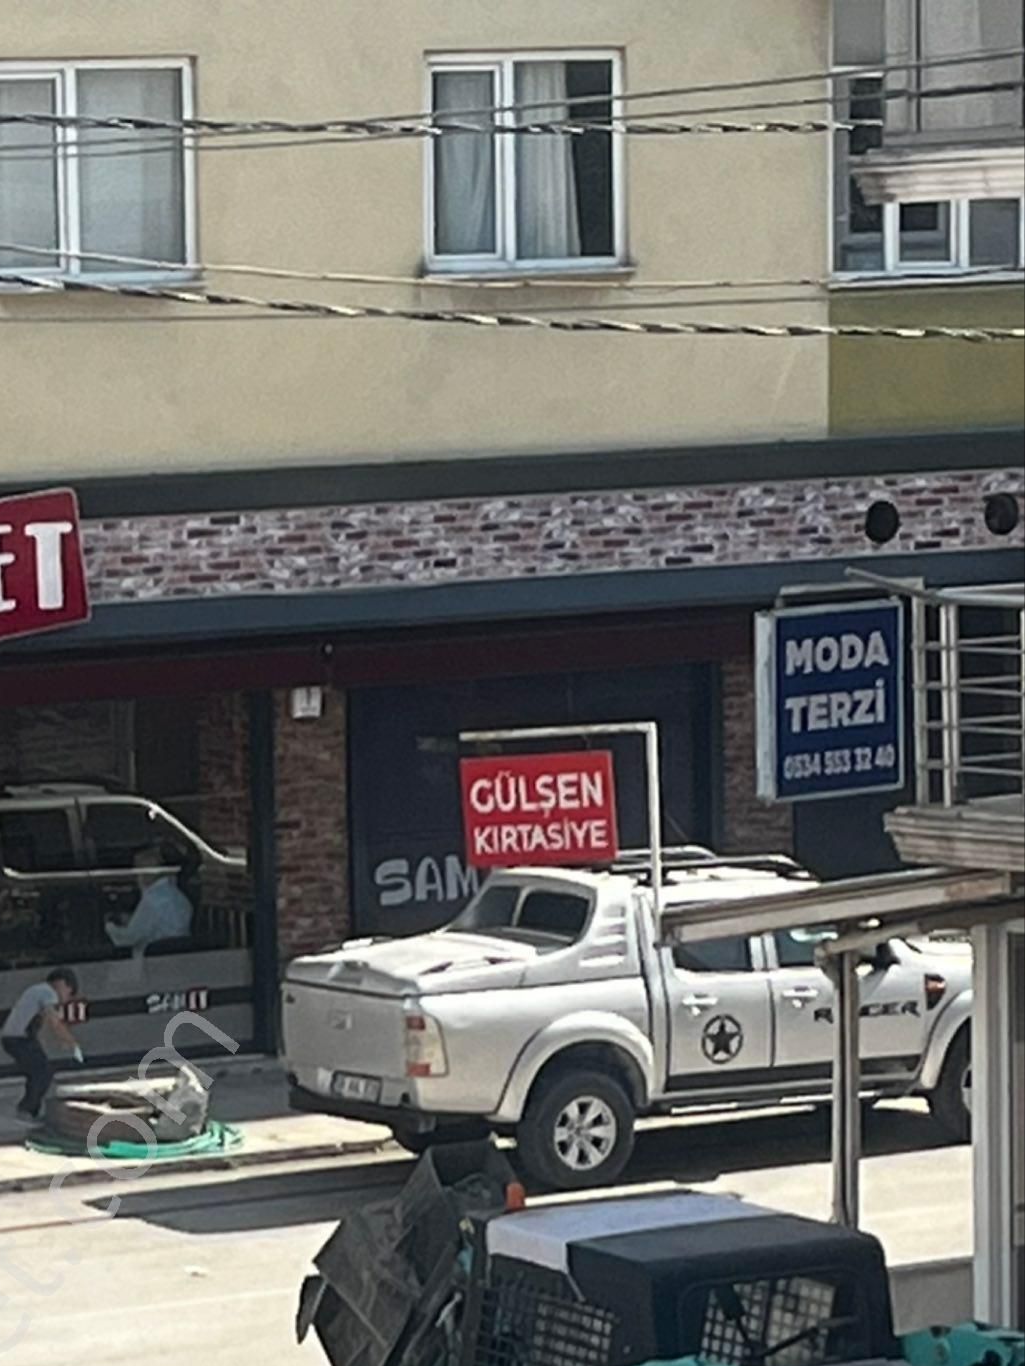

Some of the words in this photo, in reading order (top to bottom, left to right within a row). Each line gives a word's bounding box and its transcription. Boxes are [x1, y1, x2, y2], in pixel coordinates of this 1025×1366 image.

[785, 630, 889, 675] MODA
[784, 677, 885, 733] TERZİ
[470, 771, 604, 818] GÜLŞEN
[474, 817, 609, 855] KIRTASİYE
